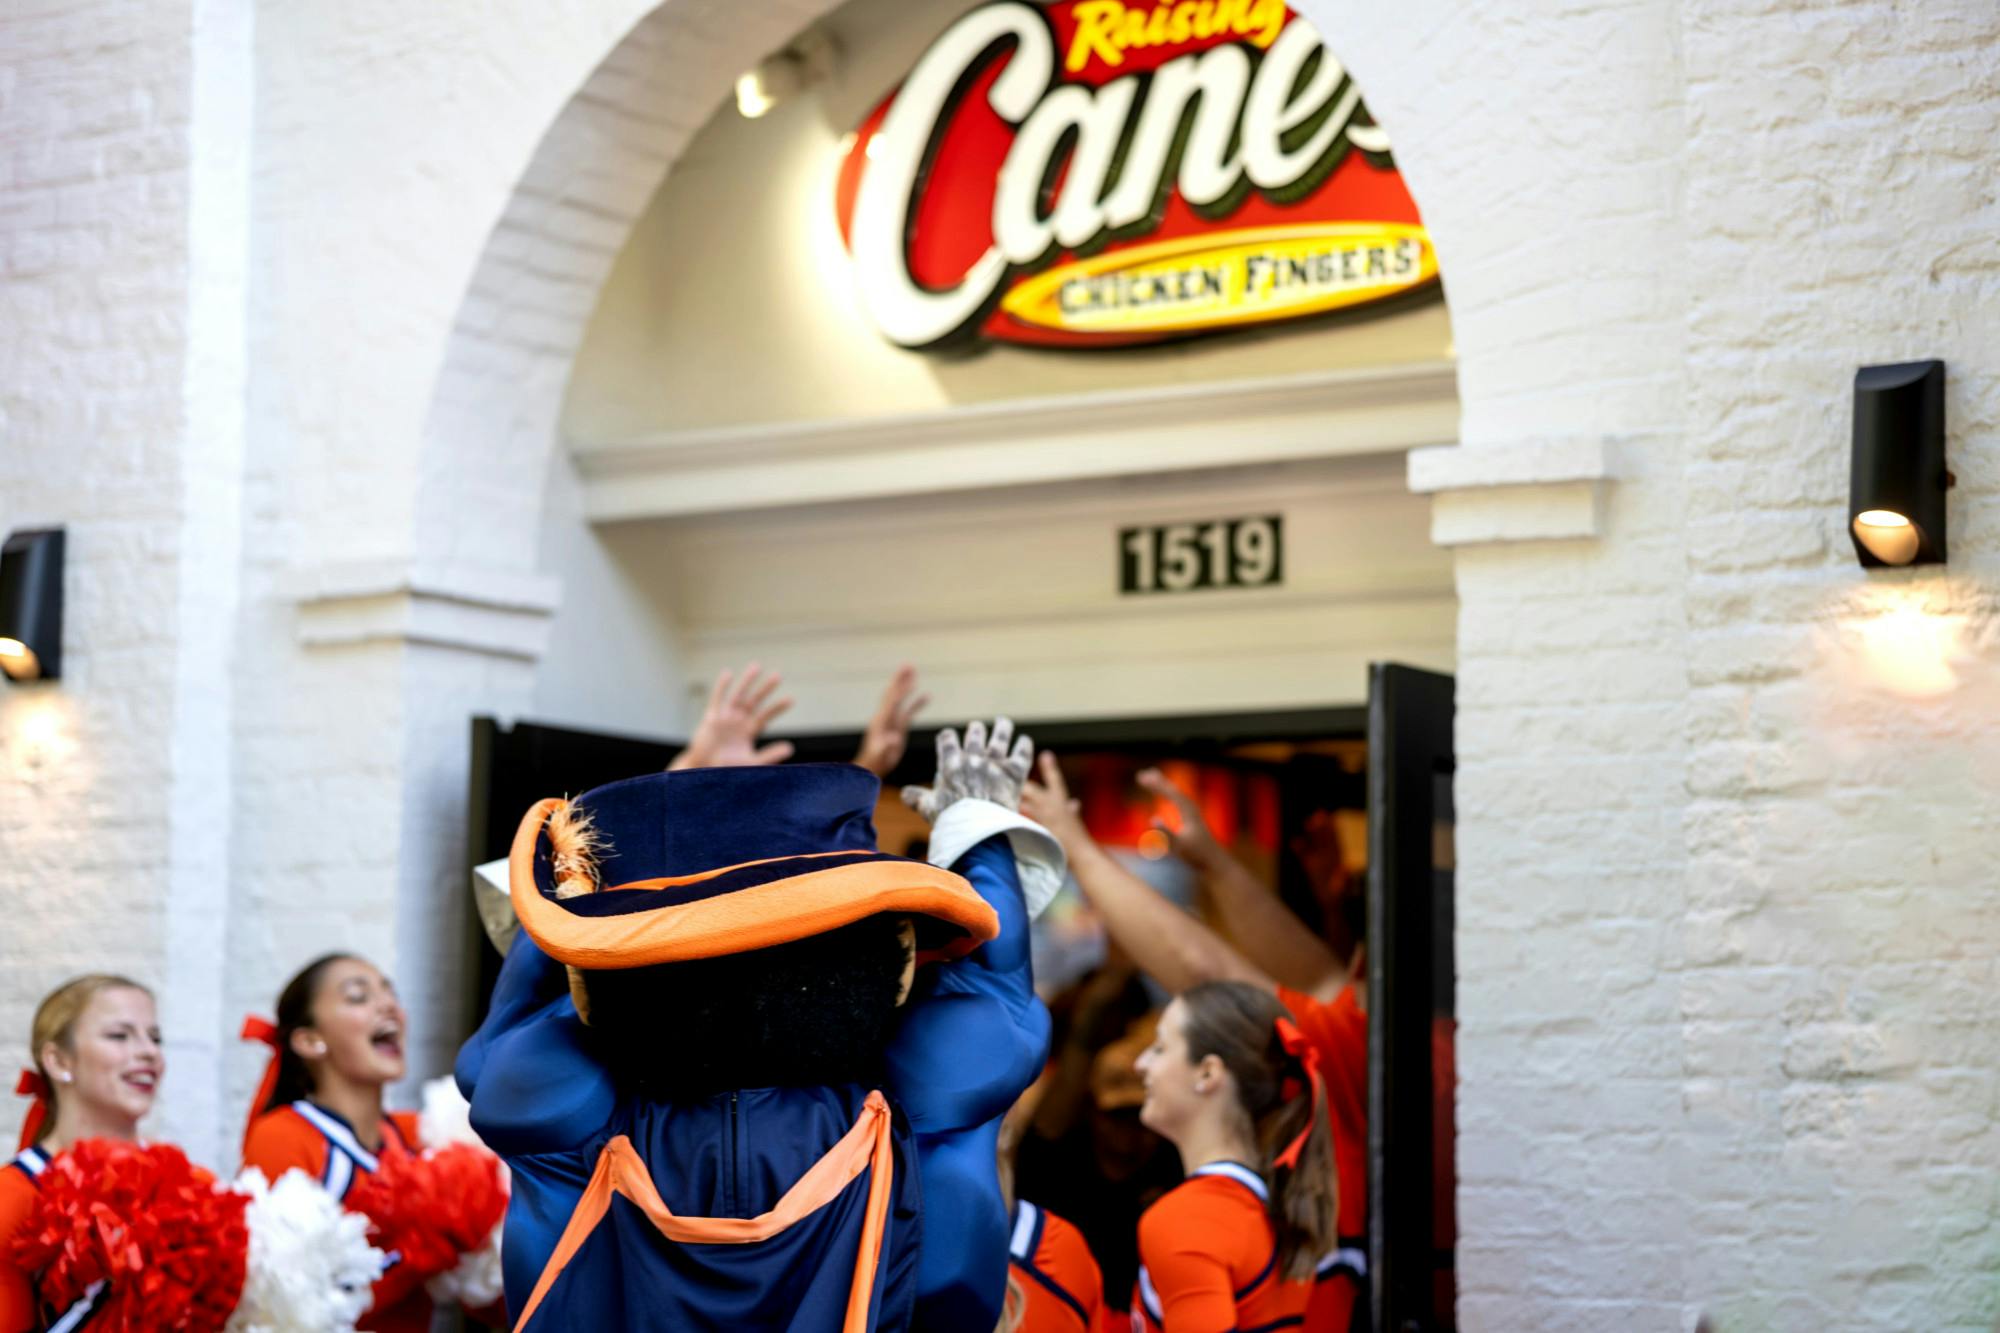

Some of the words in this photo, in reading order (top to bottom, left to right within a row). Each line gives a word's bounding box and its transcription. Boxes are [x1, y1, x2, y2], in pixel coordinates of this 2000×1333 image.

[1065, 0, 1286, 72] Raising
[850, 0, 1392, 347] Cane
[1060, 266, 1223, 315] CHICKEN
[1244, 239, 1414, 292] FINGERS
[1124, 516, 1277, 591] 1519
